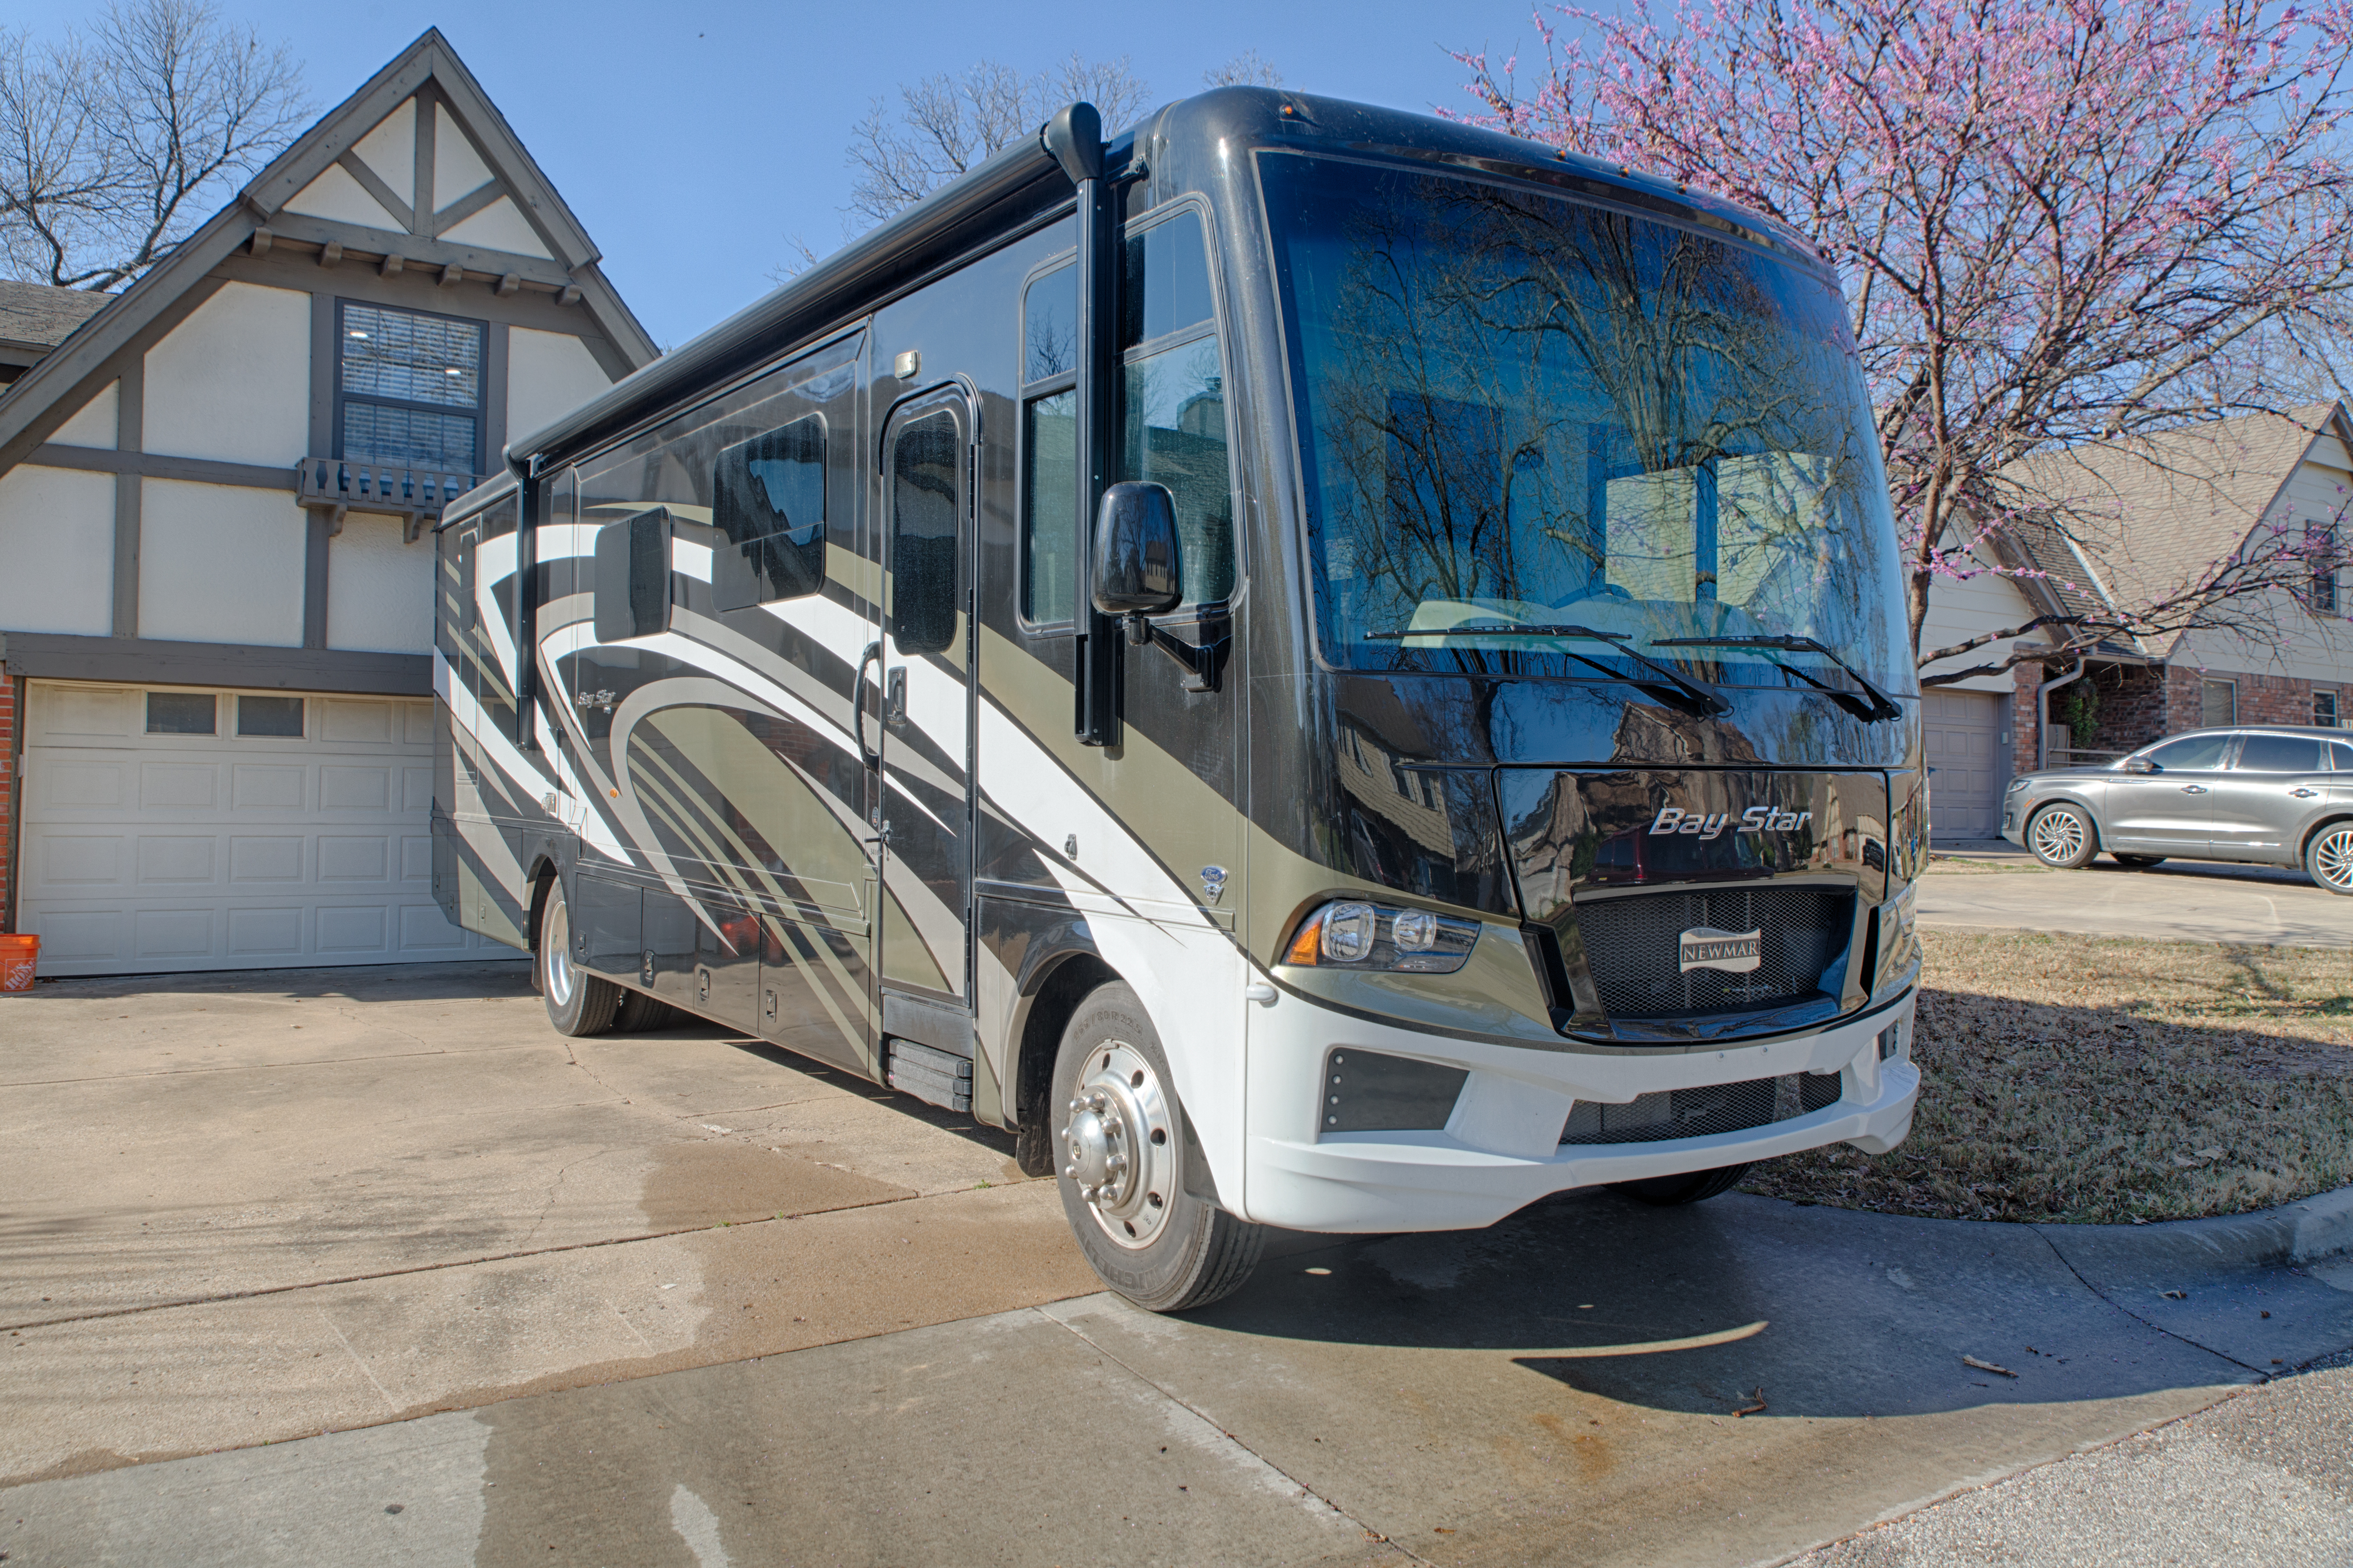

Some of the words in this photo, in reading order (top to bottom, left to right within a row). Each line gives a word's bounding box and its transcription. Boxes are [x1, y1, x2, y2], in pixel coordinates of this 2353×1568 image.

[578, 692, 595, 708] Bay
[595, 689, 616, 704] Star
[1648, 807, 1729, 840] Bay
[1736, 806, 1813, 832] Star
[1204, 869, 1220, 880] Ford
[1682, 941, 1759, 961] NEWMAR
[5, 958, 36, 989] HOME
[9, 962, 26, 975] THE
[19, 969, 35, 989] DEPO
[1074, 1220, 1164, 1291] MICHELIN
